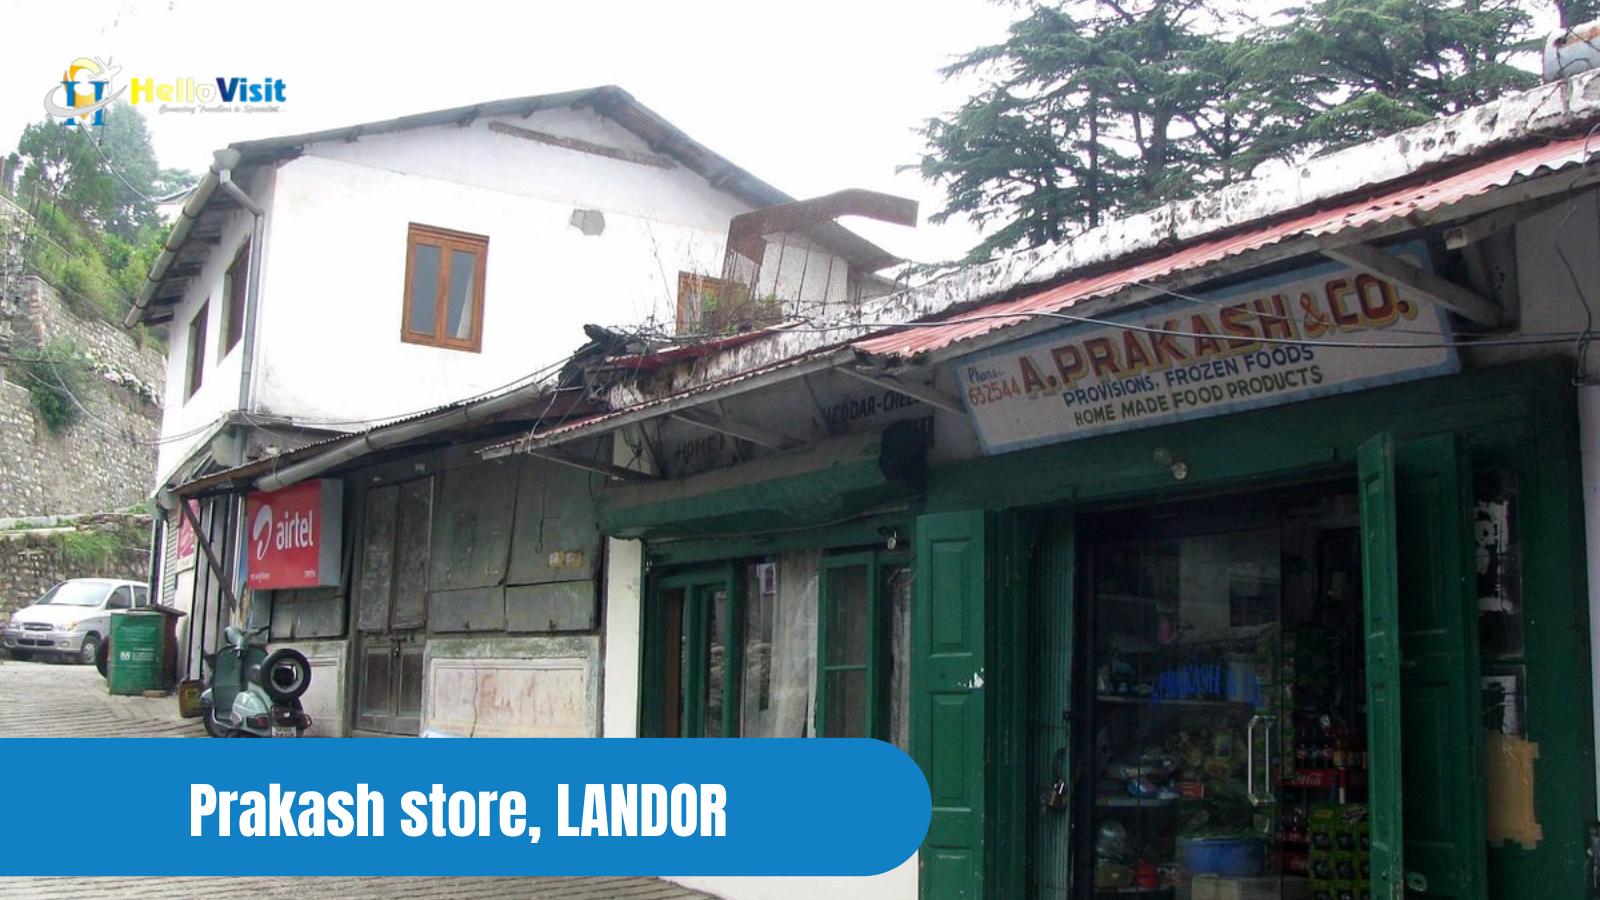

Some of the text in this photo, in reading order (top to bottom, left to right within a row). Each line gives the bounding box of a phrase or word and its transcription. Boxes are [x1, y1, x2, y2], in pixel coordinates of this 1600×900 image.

[968, 377, 1021, 406] 632544
[1062, 345, 1314, 407] PROVISIONS, FROZEN FOODS
[1074, 365, 1323, 426] HOME MADE FOOD PRODUCTS
[276, 510, 314, 551] airtel
